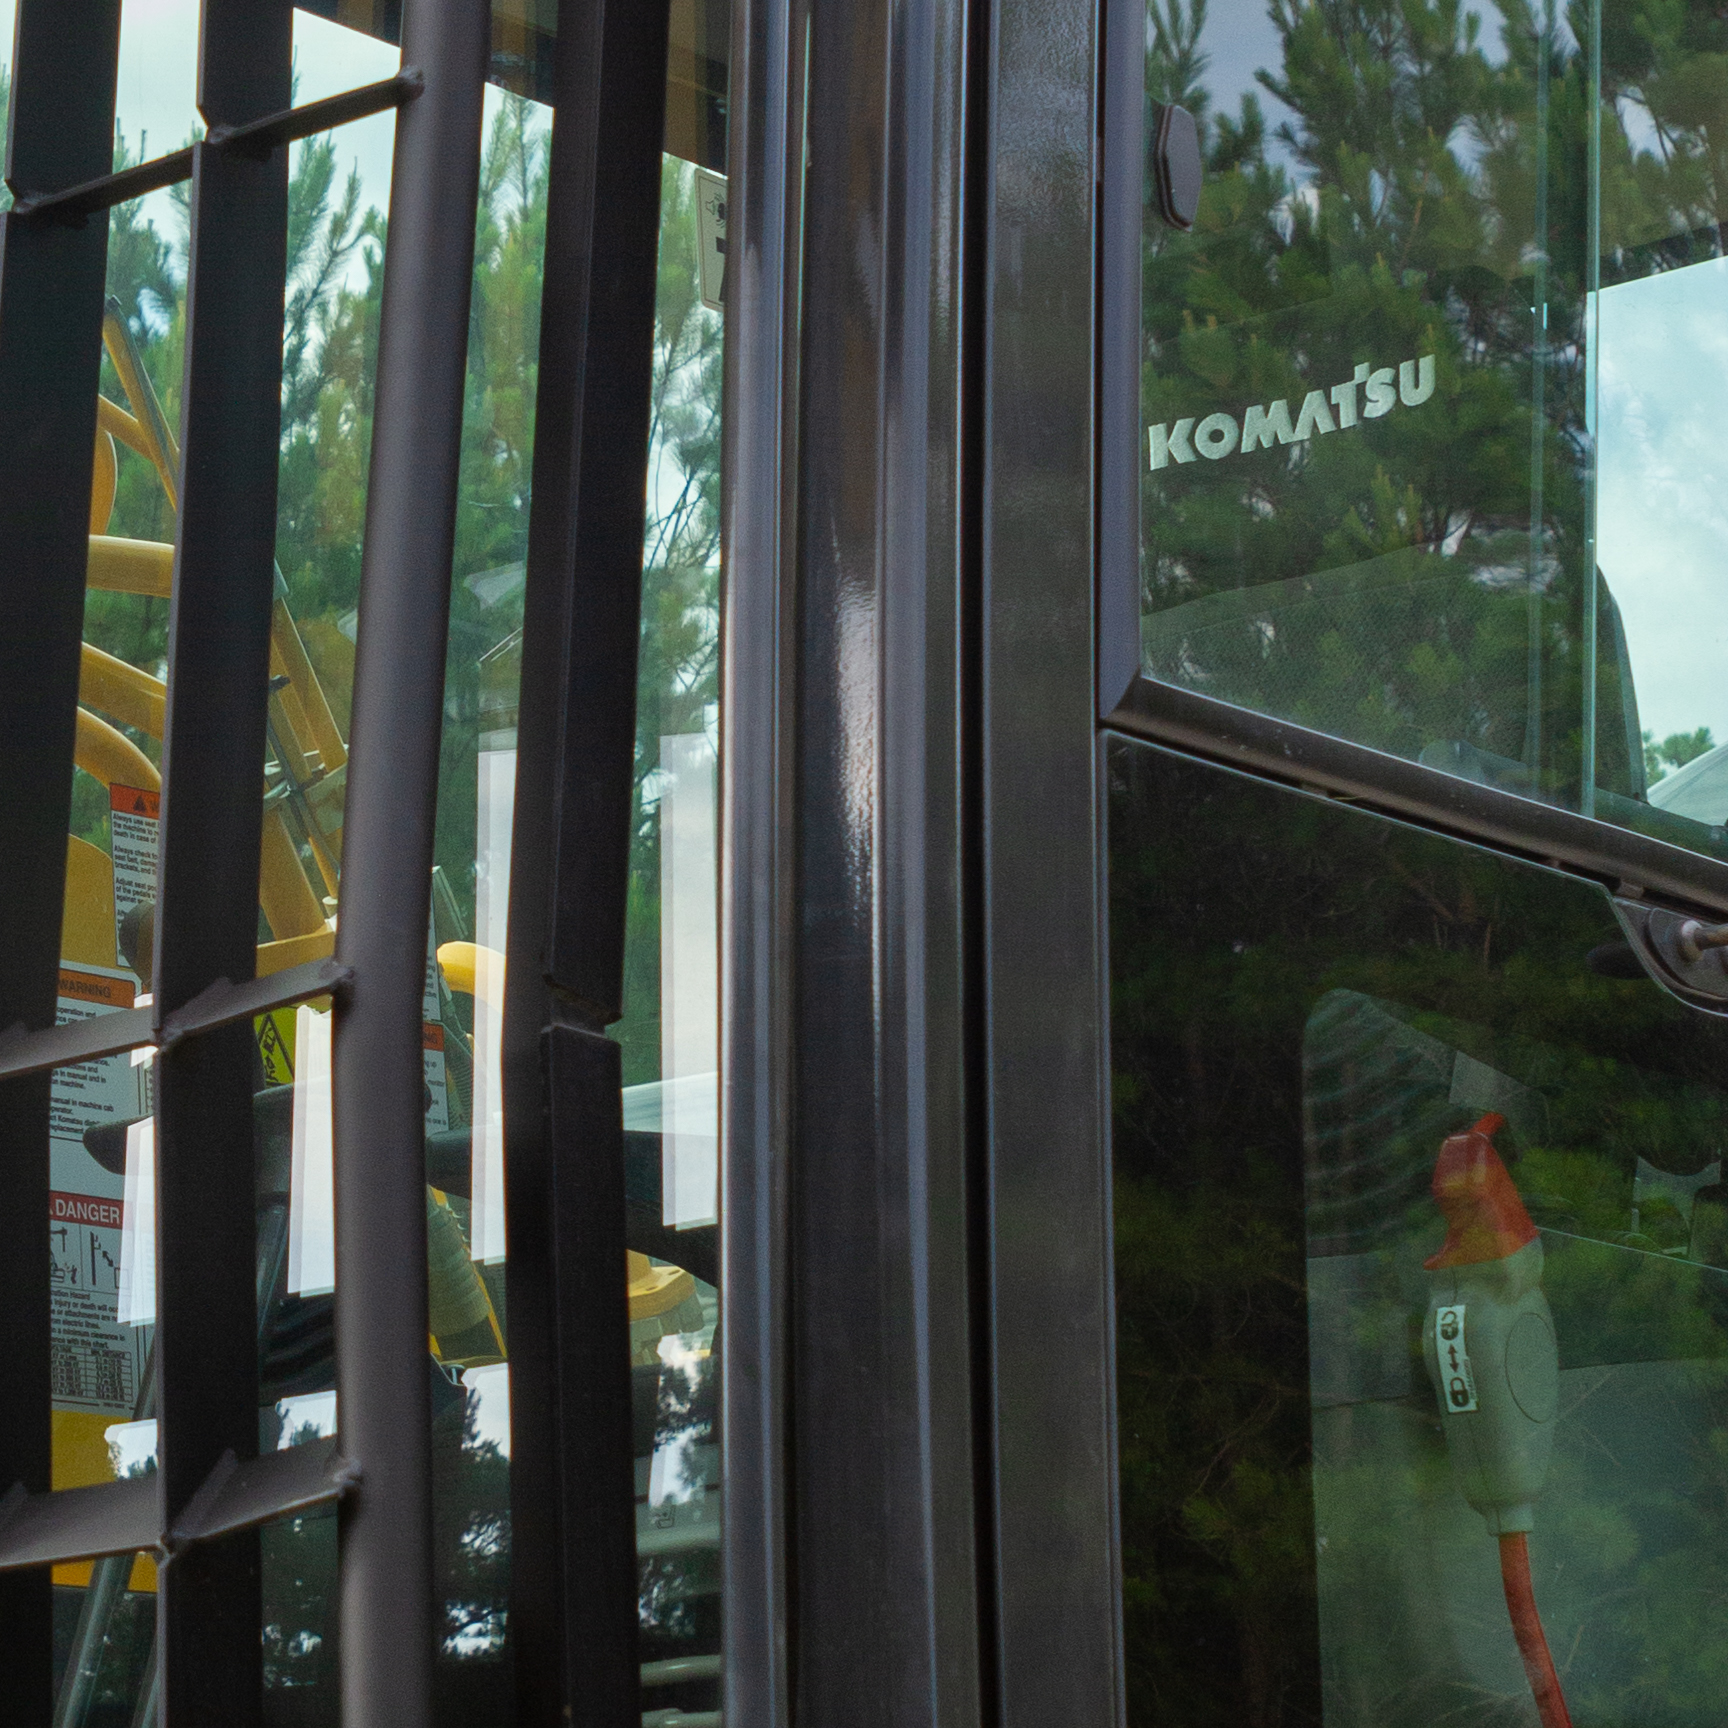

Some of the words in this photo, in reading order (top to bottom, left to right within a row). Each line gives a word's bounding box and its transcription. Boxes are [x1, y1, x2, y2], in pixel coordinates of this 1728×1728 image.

[1149, 354, 1435, 471] KOMATSU
[59, 978, 111, 999] WARNING
[67, 1071, 87, 1081] manual
[78, 1101, 102, 1110] machine
[55, 1198, 121, 1226] DANGER
